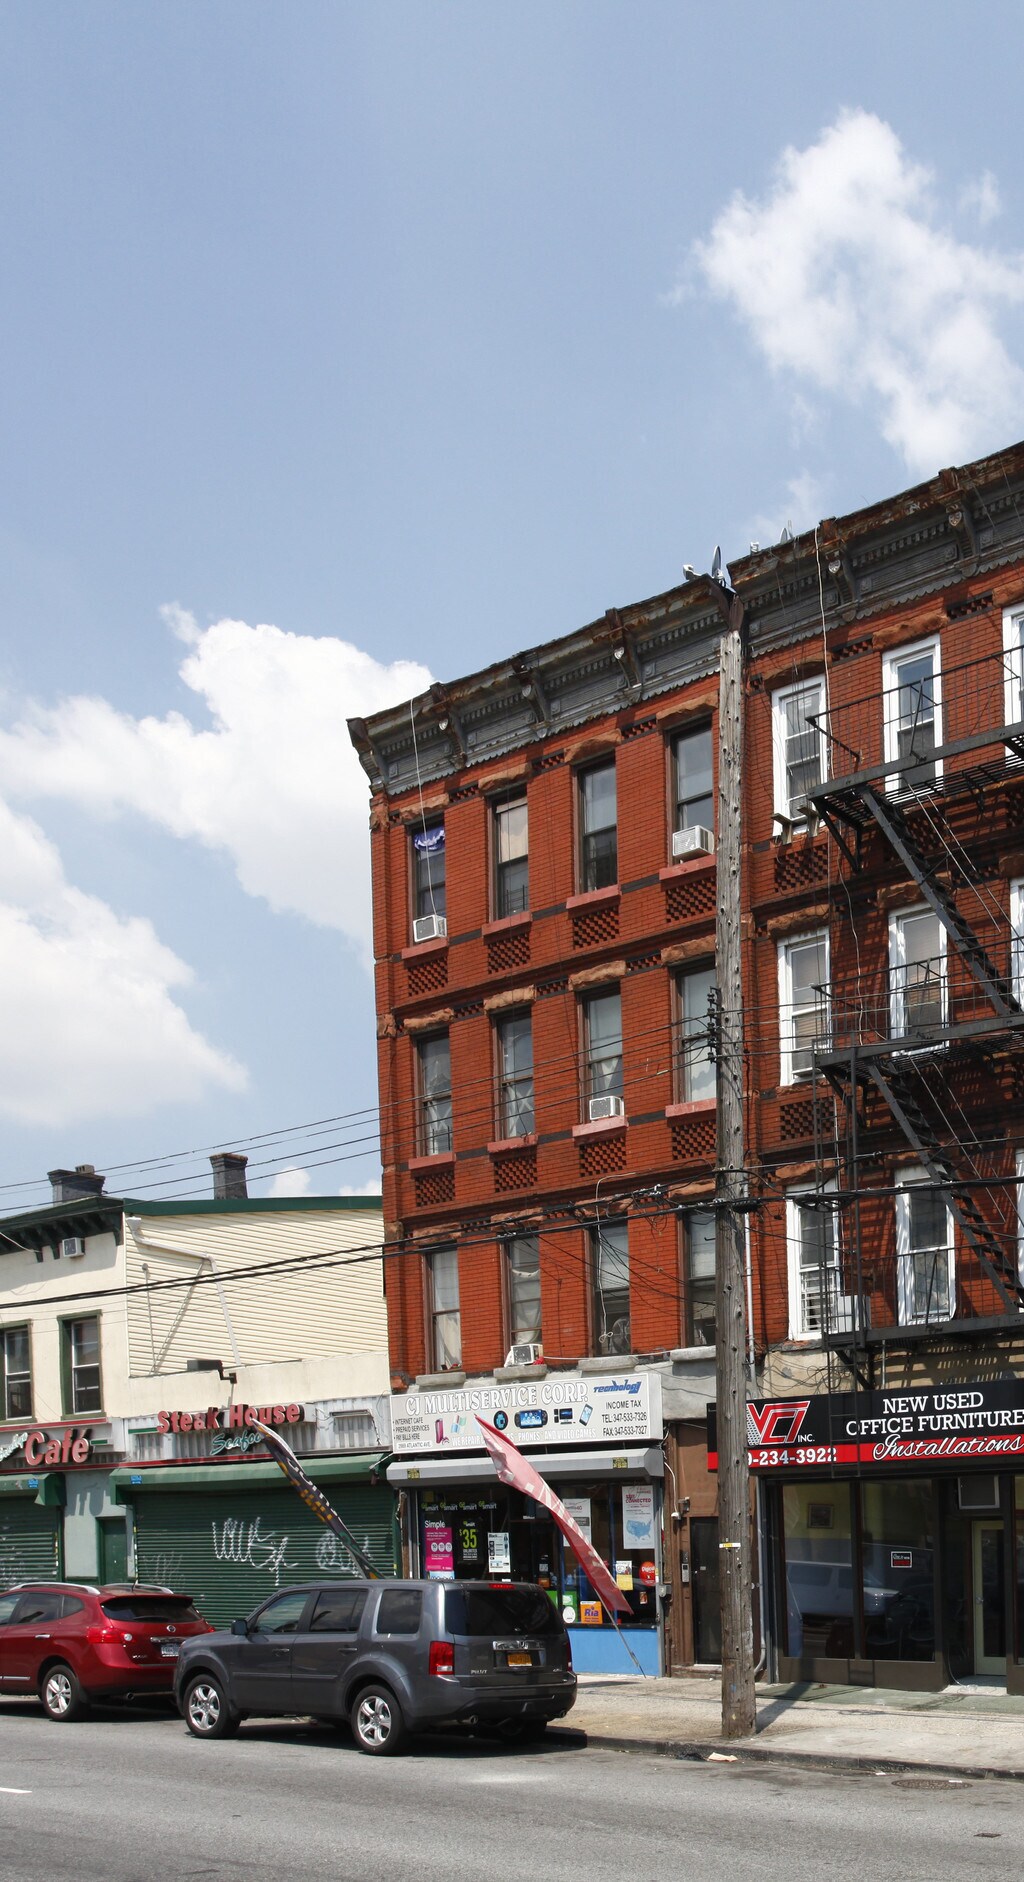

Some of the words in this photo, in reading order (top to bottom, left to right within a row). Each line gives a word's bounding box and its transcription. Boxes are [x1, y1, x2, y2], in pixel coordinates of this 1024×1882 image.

[405, 1396, 421, 1416] CJ
[424, 1385, 537, 1415] MULTISERVICE
[541, 1382, 588, 1405] CORP.
[605, 1400, 630, 1410] INCOME
[630, 1399, 642, 1408] TAX
[883, 1395, 929, 1414] NEW
[933, 1391, 984, 1411] USED
[157, 1407, 220, 1434] Steak
[230, 1403, 301, 1428] House
[845, 1416, 914, 1436] OFFICE
[210, 1430, 263, 1456] Seafoo
[545, 1430, 556, 1440] AND
[557, 1430, 575, 1440] VIDEO
[575, 1428, 596, 1439] GAMES
[797, 1433, 816, 1443] INC.
[25, 1428, 91, 1466] Café
[747, 1447, 837, 1466] -234-3922
[872, 1433, 1024, 1461] Installations
[424, 1520, 446, 1530] Simple
[458, 1528, 478, 1548] $35
[584, 1606, 599, 1617] Ria
